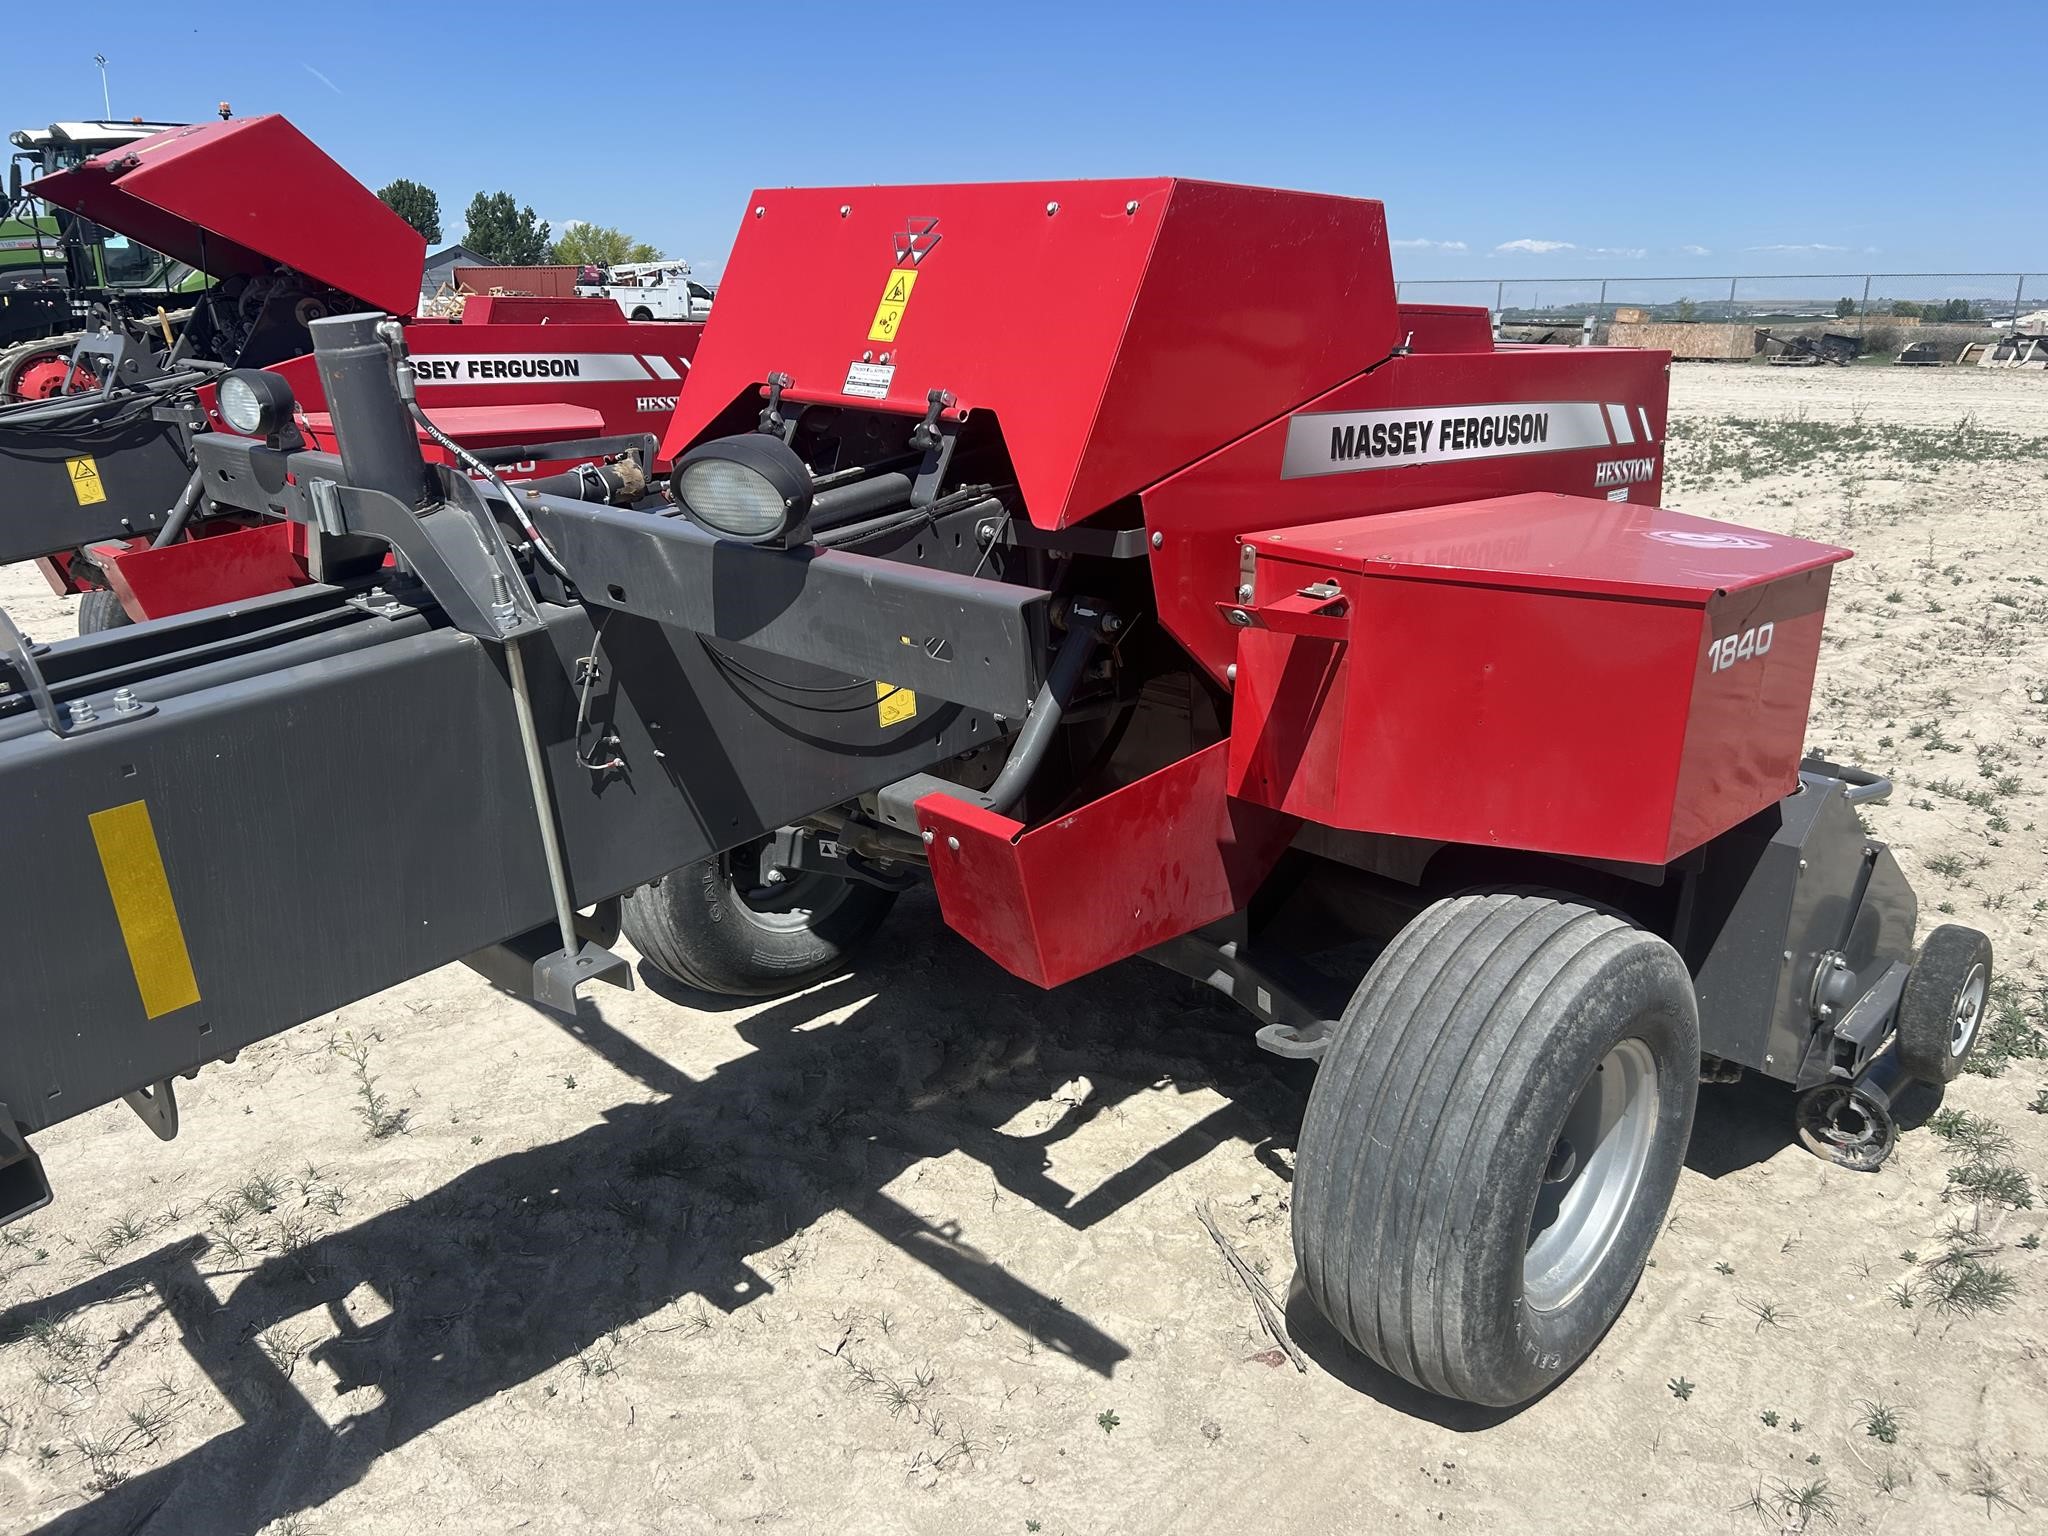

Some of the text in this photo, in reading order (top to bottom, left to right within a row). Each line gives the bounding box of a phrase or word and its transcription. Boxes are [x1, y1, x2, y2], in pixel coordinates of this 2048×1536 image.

[409, 359, 580, 380] SSEY FERGUSON
[636, 396, 680, 412] HESS
[427, 426, 461, 455] DIEHARD
[1330, 412, 1549, 461] MASSEY FERGUSON
[1594, 457, 1656, 488] HESSTON
[1708, 621, 1774, 673] 1840
